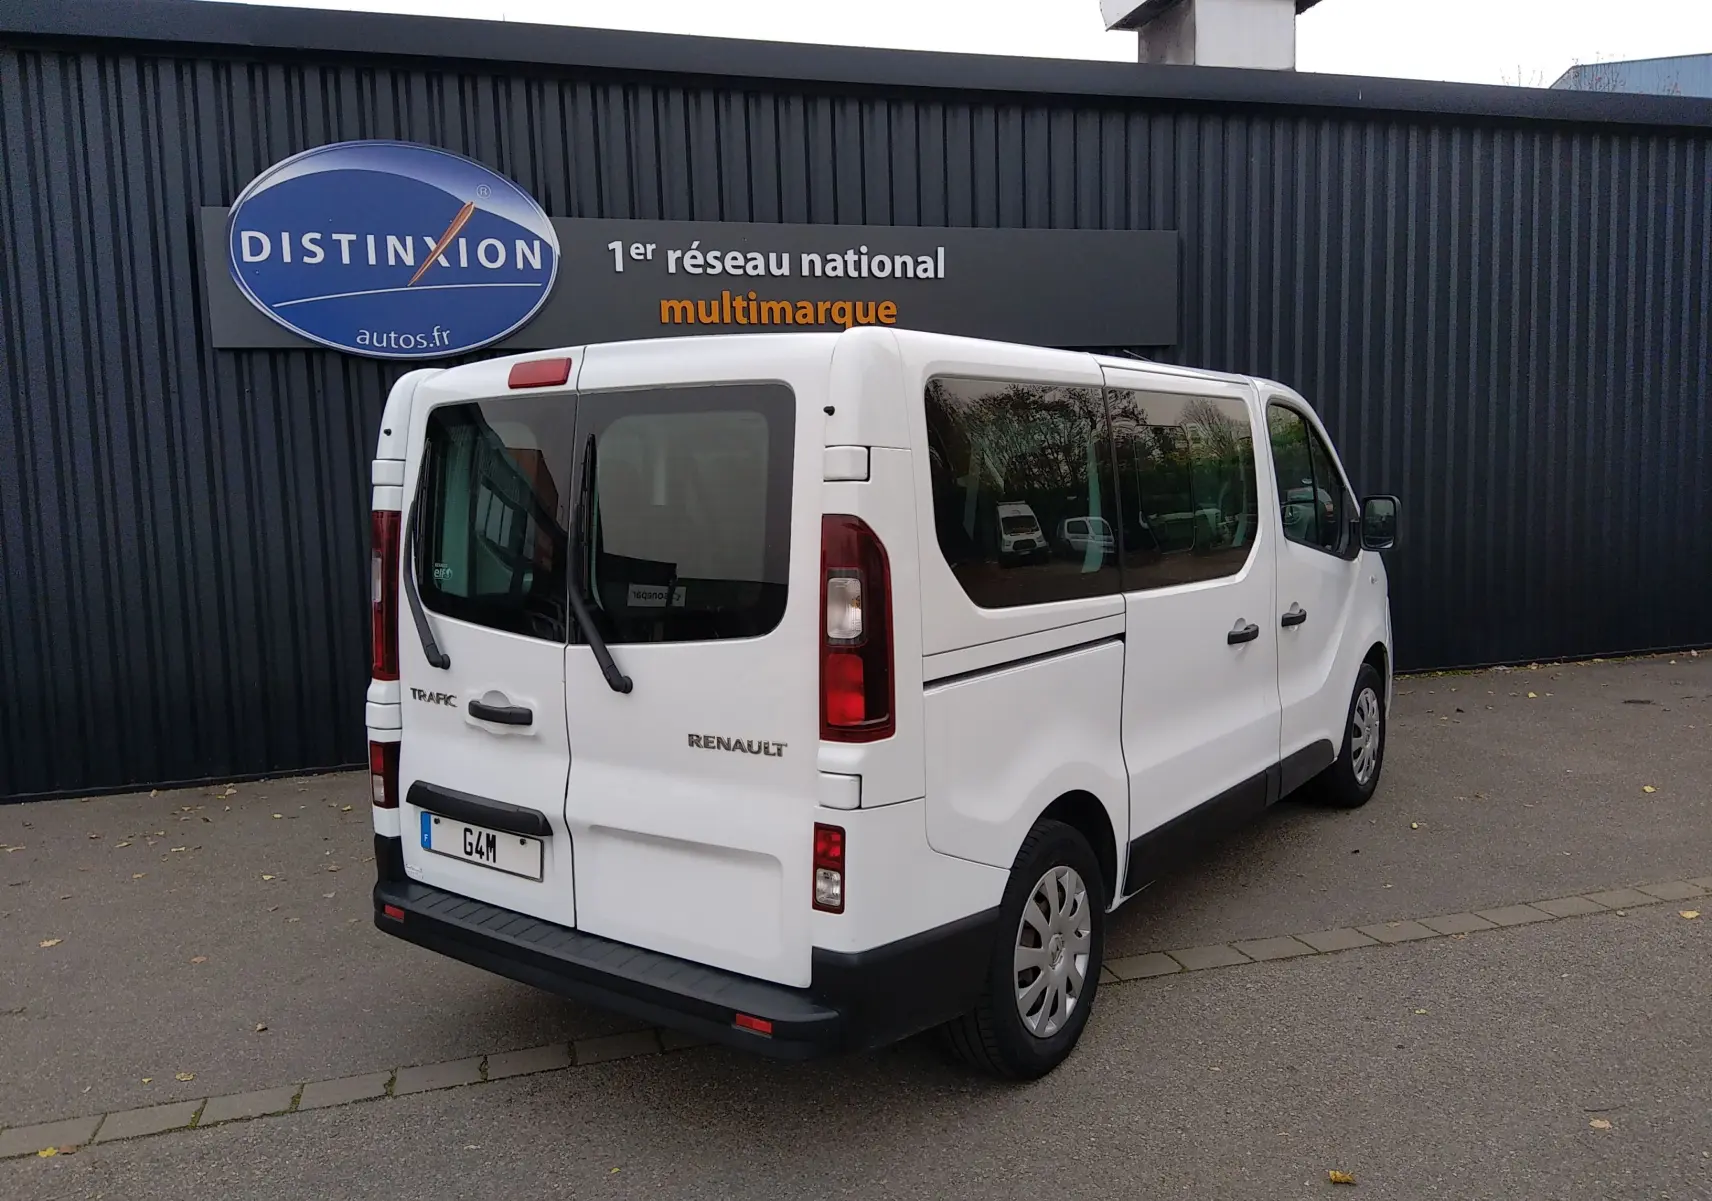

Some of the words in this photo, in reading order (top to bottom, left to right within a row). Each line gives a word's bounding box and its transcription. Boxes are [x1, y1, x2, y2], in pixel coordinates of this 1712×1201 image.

[240, 230, 542, 271] DISTINXION
[608, 240, 656, 273] 1er
[667, 240, 790, 277] réseau
[801, 245, 946, 279] national
[660, 290, 898, 329] multimarque
[356, 325, 451, 349] autos.fr
[410, 687, 458, 708] TRAFIC
[688, 733, 788, 758] RENAULT
[463, 827, 497, 863] G4M
